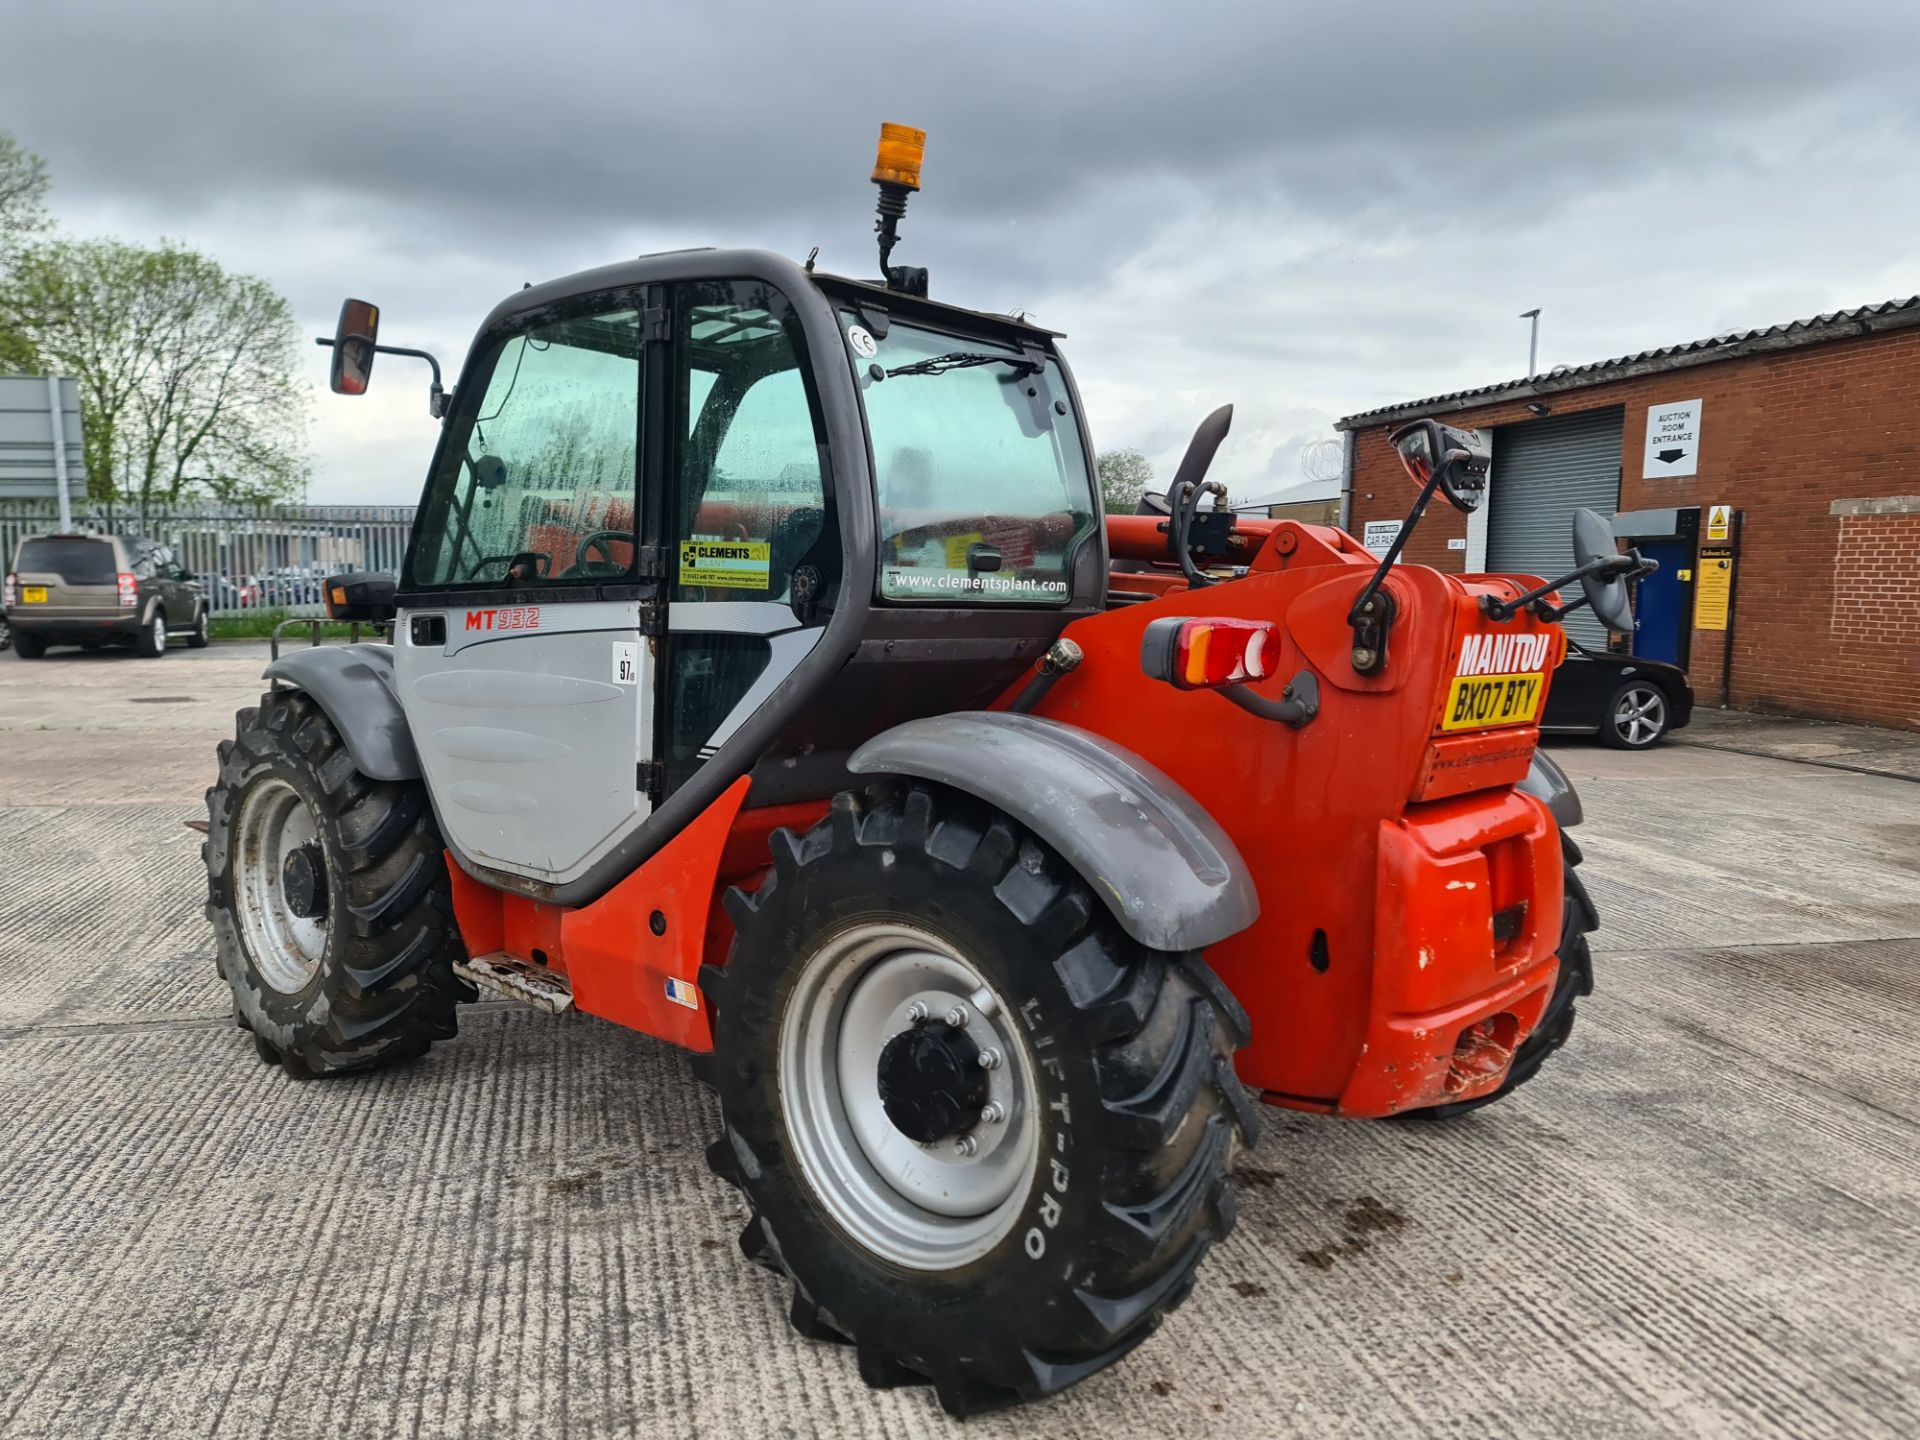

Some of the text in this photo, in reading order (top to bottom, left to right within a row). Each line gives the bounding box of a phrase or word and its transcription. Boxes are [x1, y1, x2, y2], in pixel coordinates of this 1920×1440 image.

[1658, 411, 1691, 422] AUCTION
[1662, 423, 1685, 432] ROOM
[1652, 432, 1692, 444] ENTRANCE
[1366, 535, 1380, 546] CAR
[698, 547, 750, 559] CLEMENTS
[698, 559, 726, 568] PLANT
[895, 573, 1067, 593] www.clementsplant.com
[1456, 634, 1550, 677] MANITOU
[620, 660, 631, 681] 97
[1452, 679, 1537, 722] BX07 BTY
